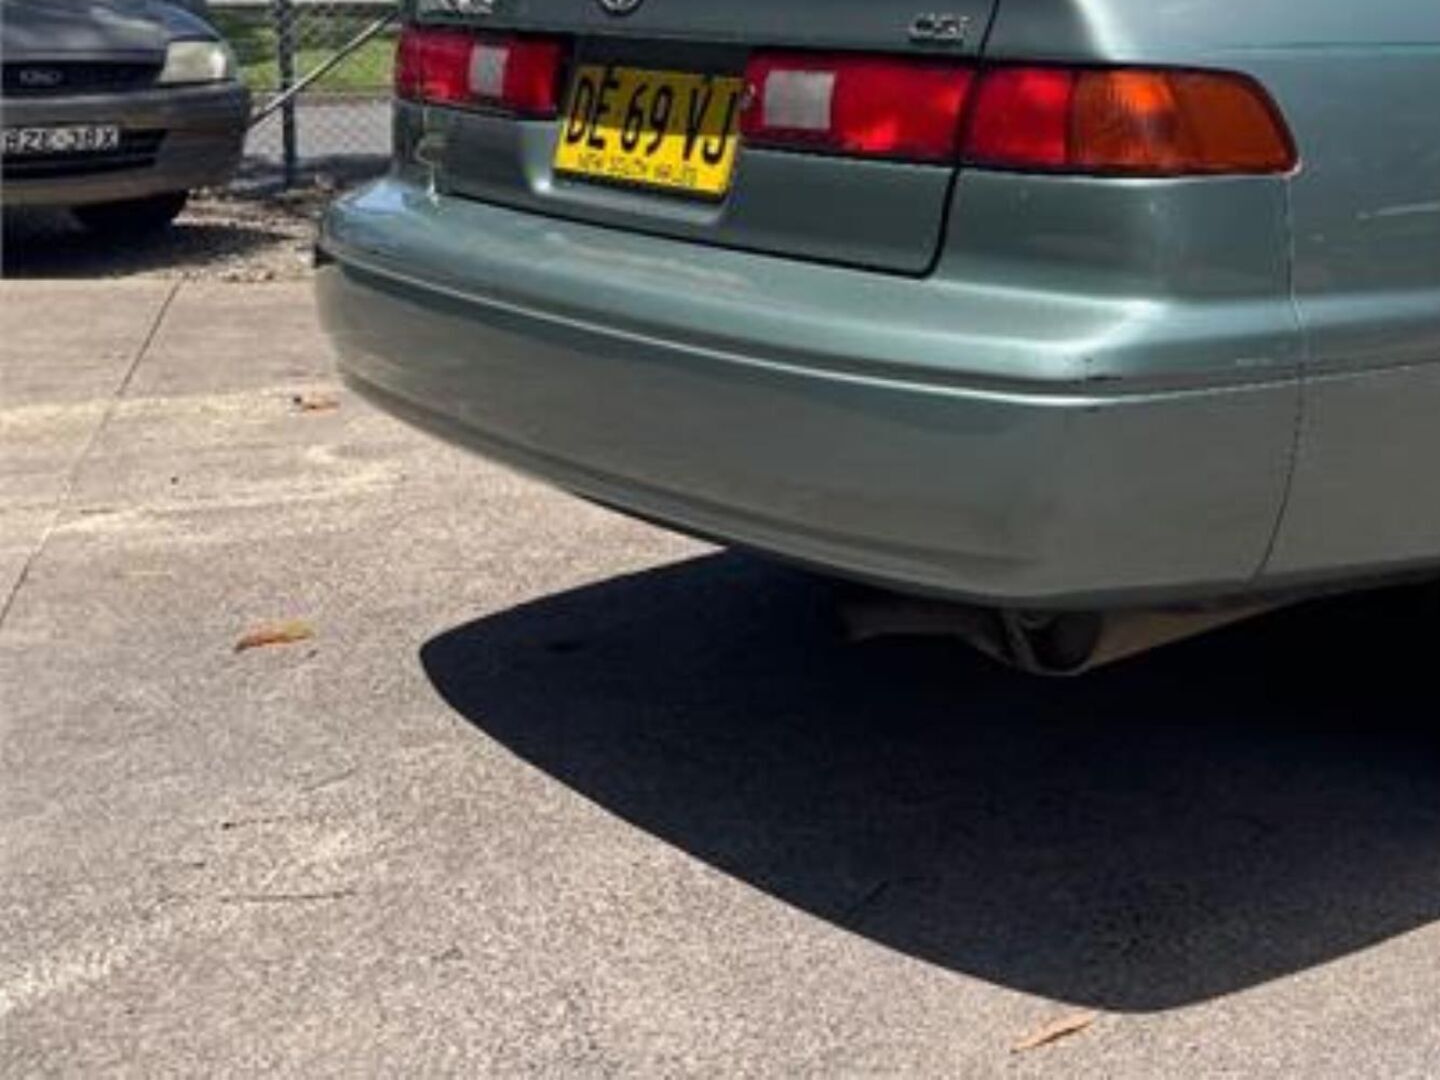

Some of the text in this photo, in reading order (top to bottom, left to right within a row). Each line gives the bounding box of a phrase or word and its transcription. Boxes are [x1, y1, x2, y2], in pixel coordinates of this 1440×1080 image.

[567, 76, 738, 165] DE 69 VJ
